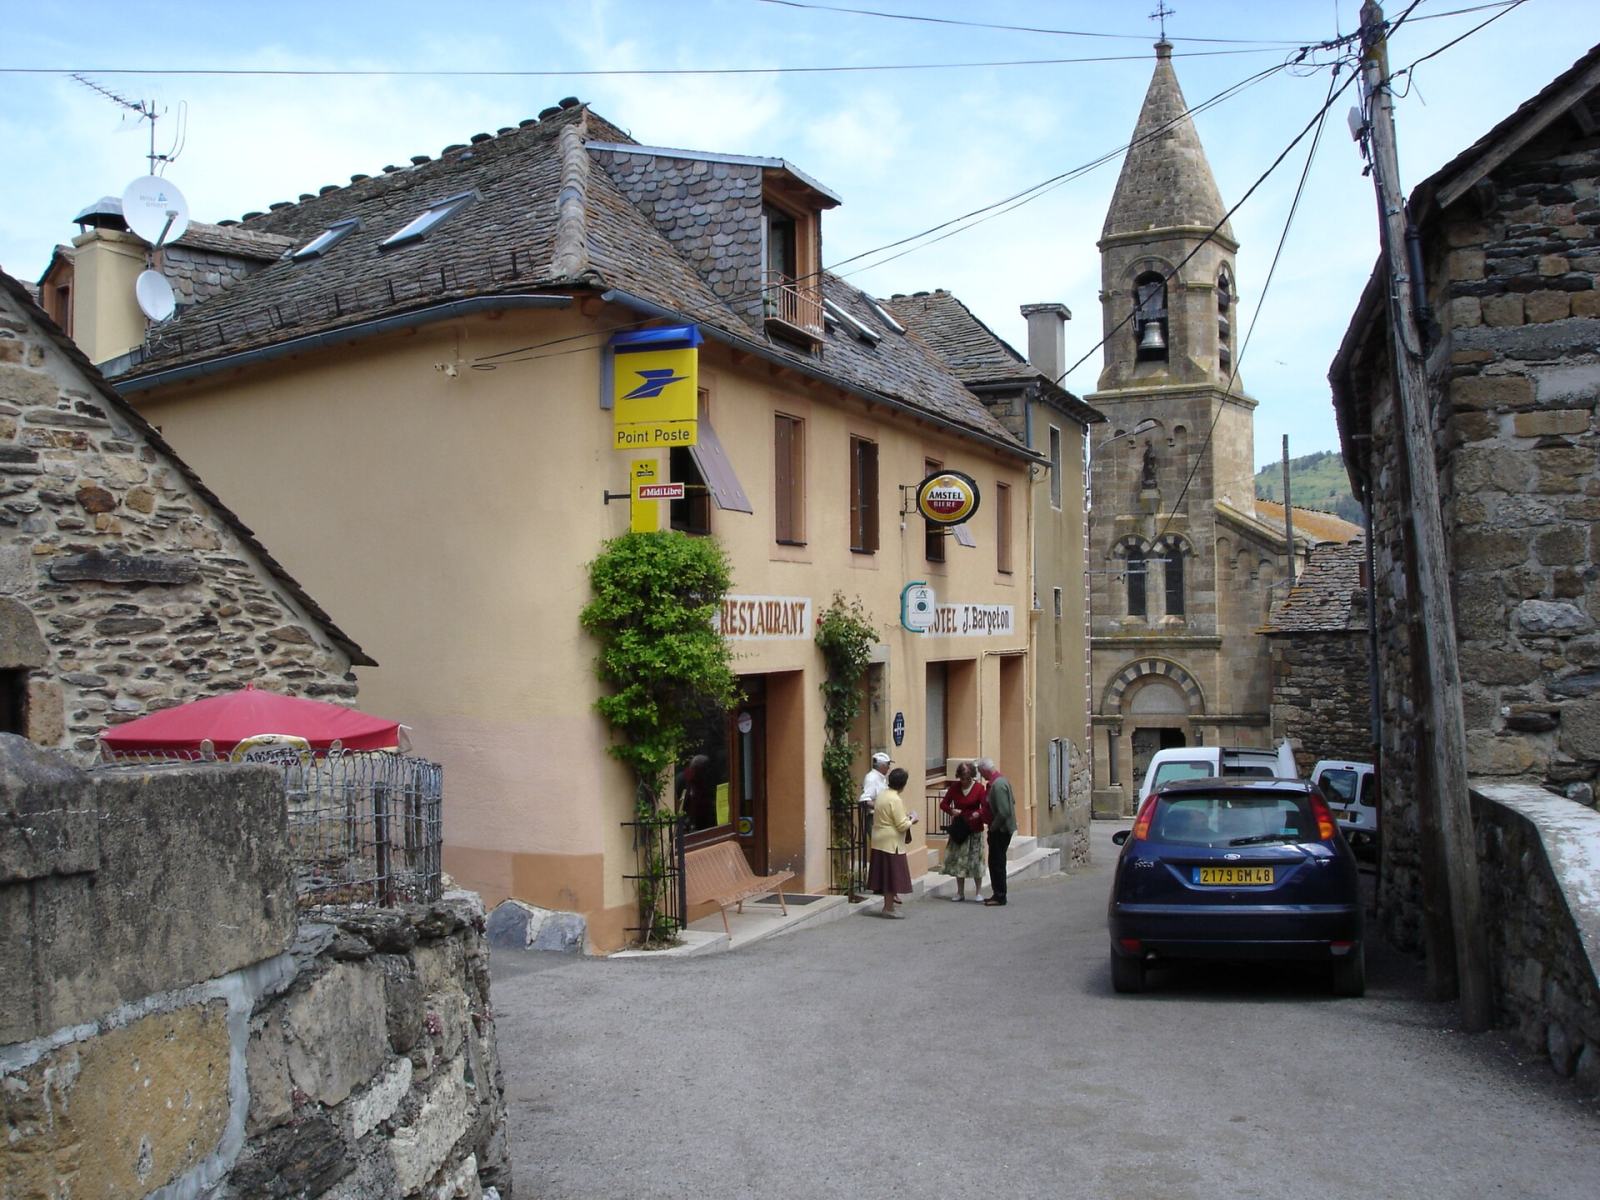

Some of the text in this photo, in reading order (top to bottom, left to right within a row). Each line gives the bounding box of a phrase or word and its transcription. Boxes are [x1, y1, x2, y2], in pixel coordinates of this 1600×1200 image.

[617, 428, 690, 443] Point Poste
[646, 486, 682, 496] Midi Libre
[928, 491, 963, 500] AMSTEL
[720, 600, 806, 635] RESTAURANT
[928, 607, 958, 633] OTEL
[1202, 868, 1271, 883] 2179 GM 48
